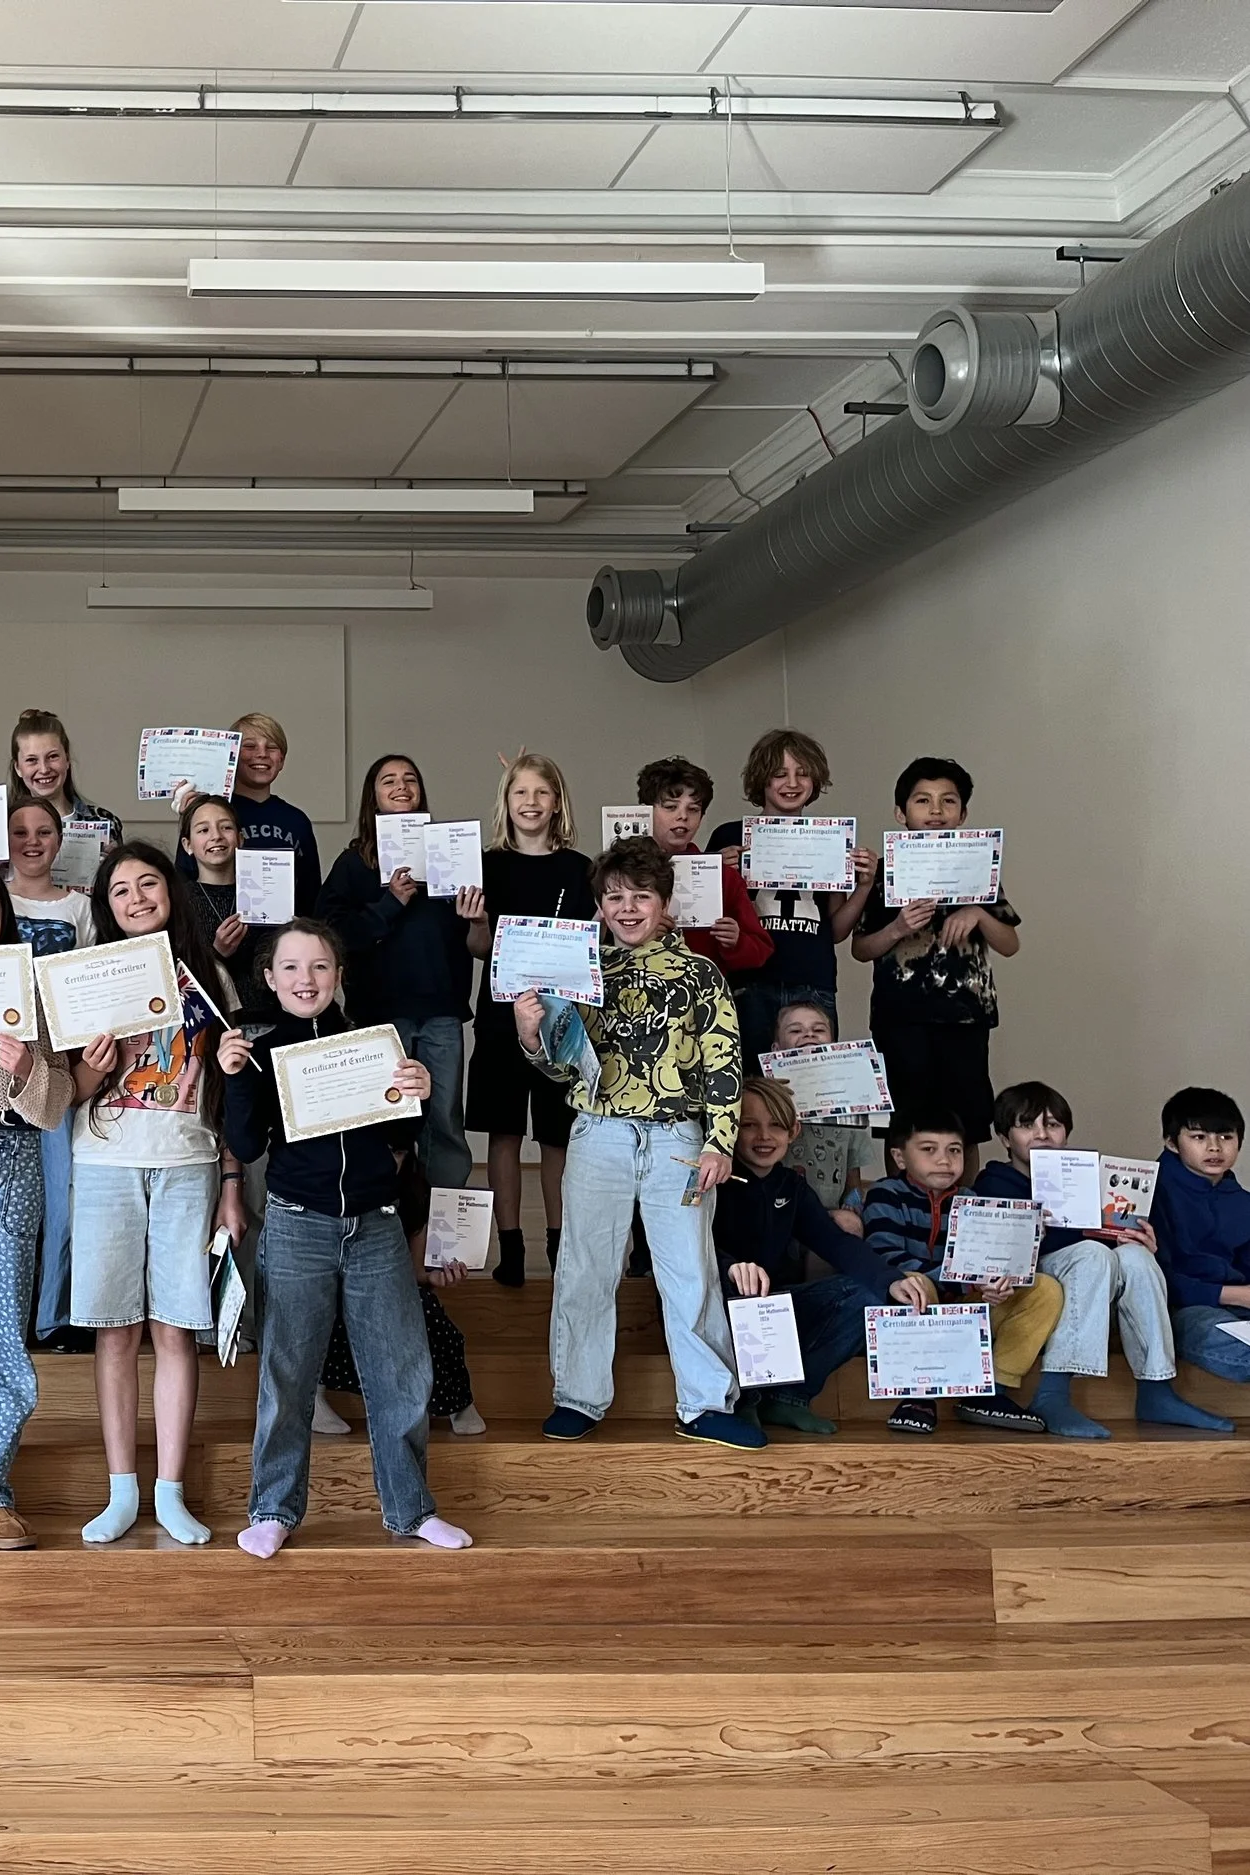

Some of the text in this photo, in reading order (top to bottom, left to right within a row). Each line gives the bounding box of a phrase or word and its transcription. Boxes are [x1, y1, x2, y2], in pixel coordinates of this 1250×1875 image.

[760, 917, 820, 936] NHATTAN
[64, 972, 100, 985] Certificate
[111, 963, 147, 975] Excellence
[302, 1062, 338, 1075] Certificate
[349, 1052, 384, 1066] Excellence
